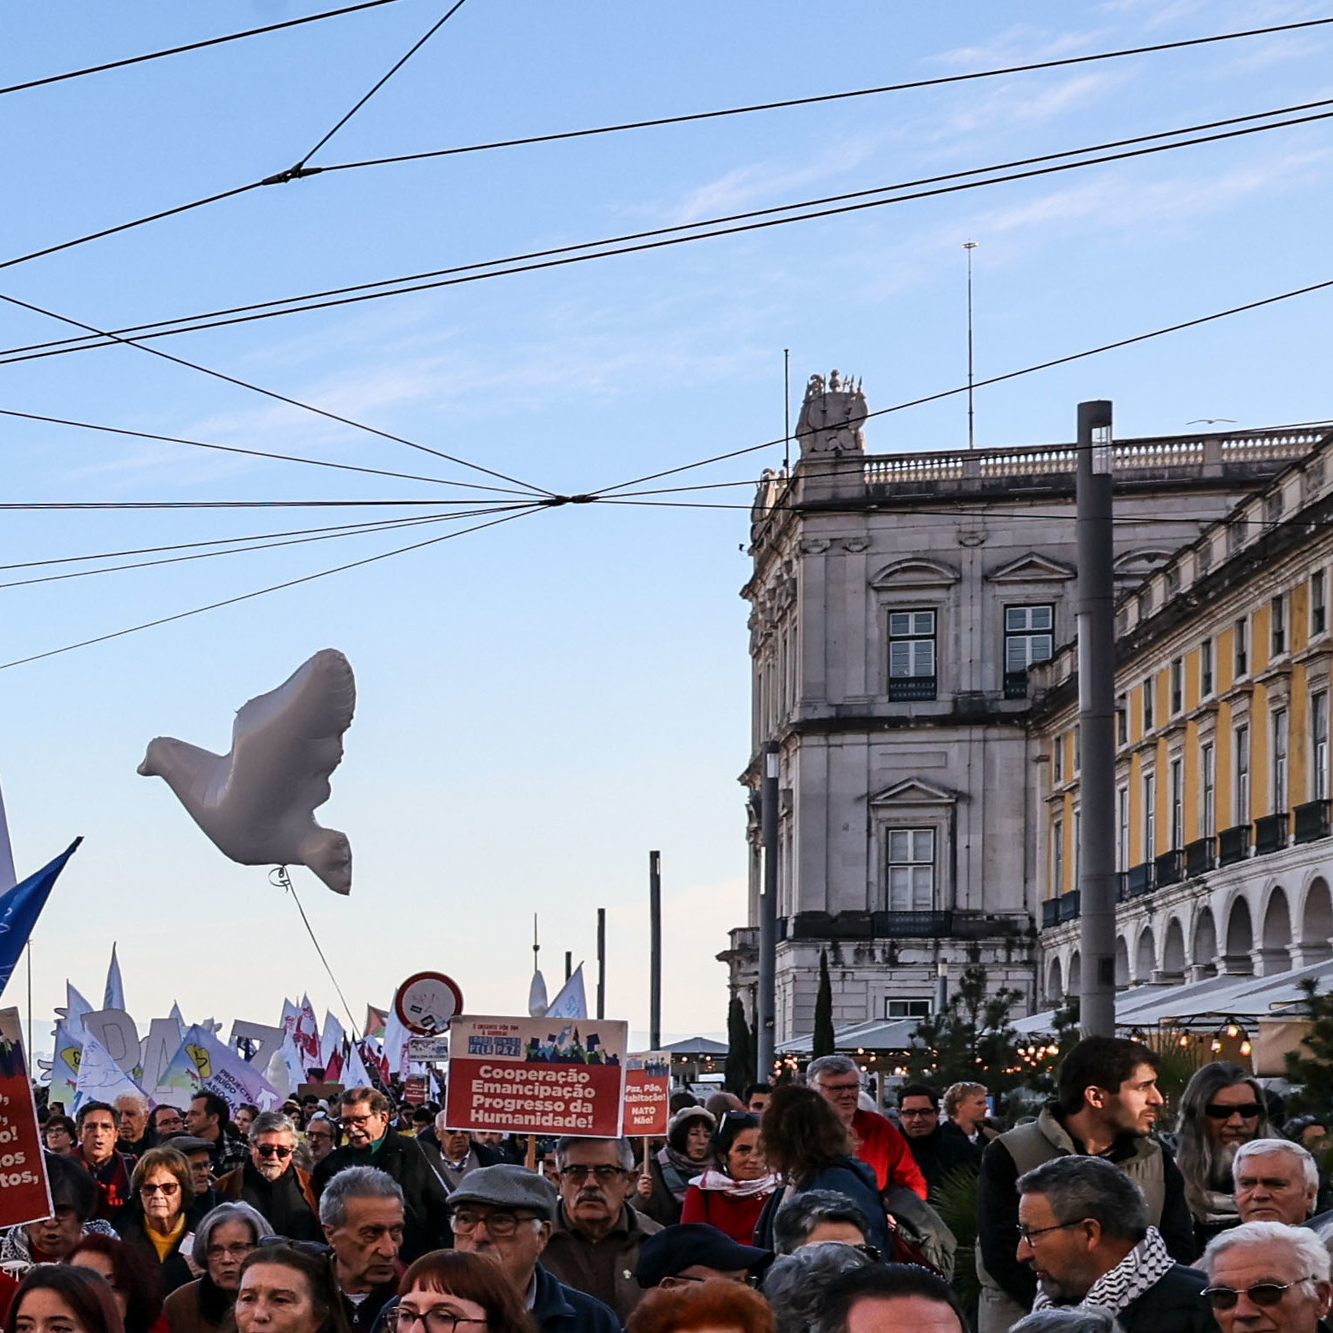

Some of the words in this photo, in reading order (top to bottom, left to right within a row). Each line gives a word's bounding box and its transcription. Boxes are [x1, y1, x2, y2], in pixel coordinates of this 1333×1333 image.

[479, 1065, 590, 1084] Cooperação
[219, 1069, 253, 1103] PROJECTO
[471, 1080, 595, 1099] Emancipação
[472, 1095, 565, 1113] Progresso
[569, 1099, 593, 1113] da
[631, 1107, 656, 1115] NATO
[470, 1109, 594, 1128] Humanidade!
[633, 1116, 653, 1124] Não!
